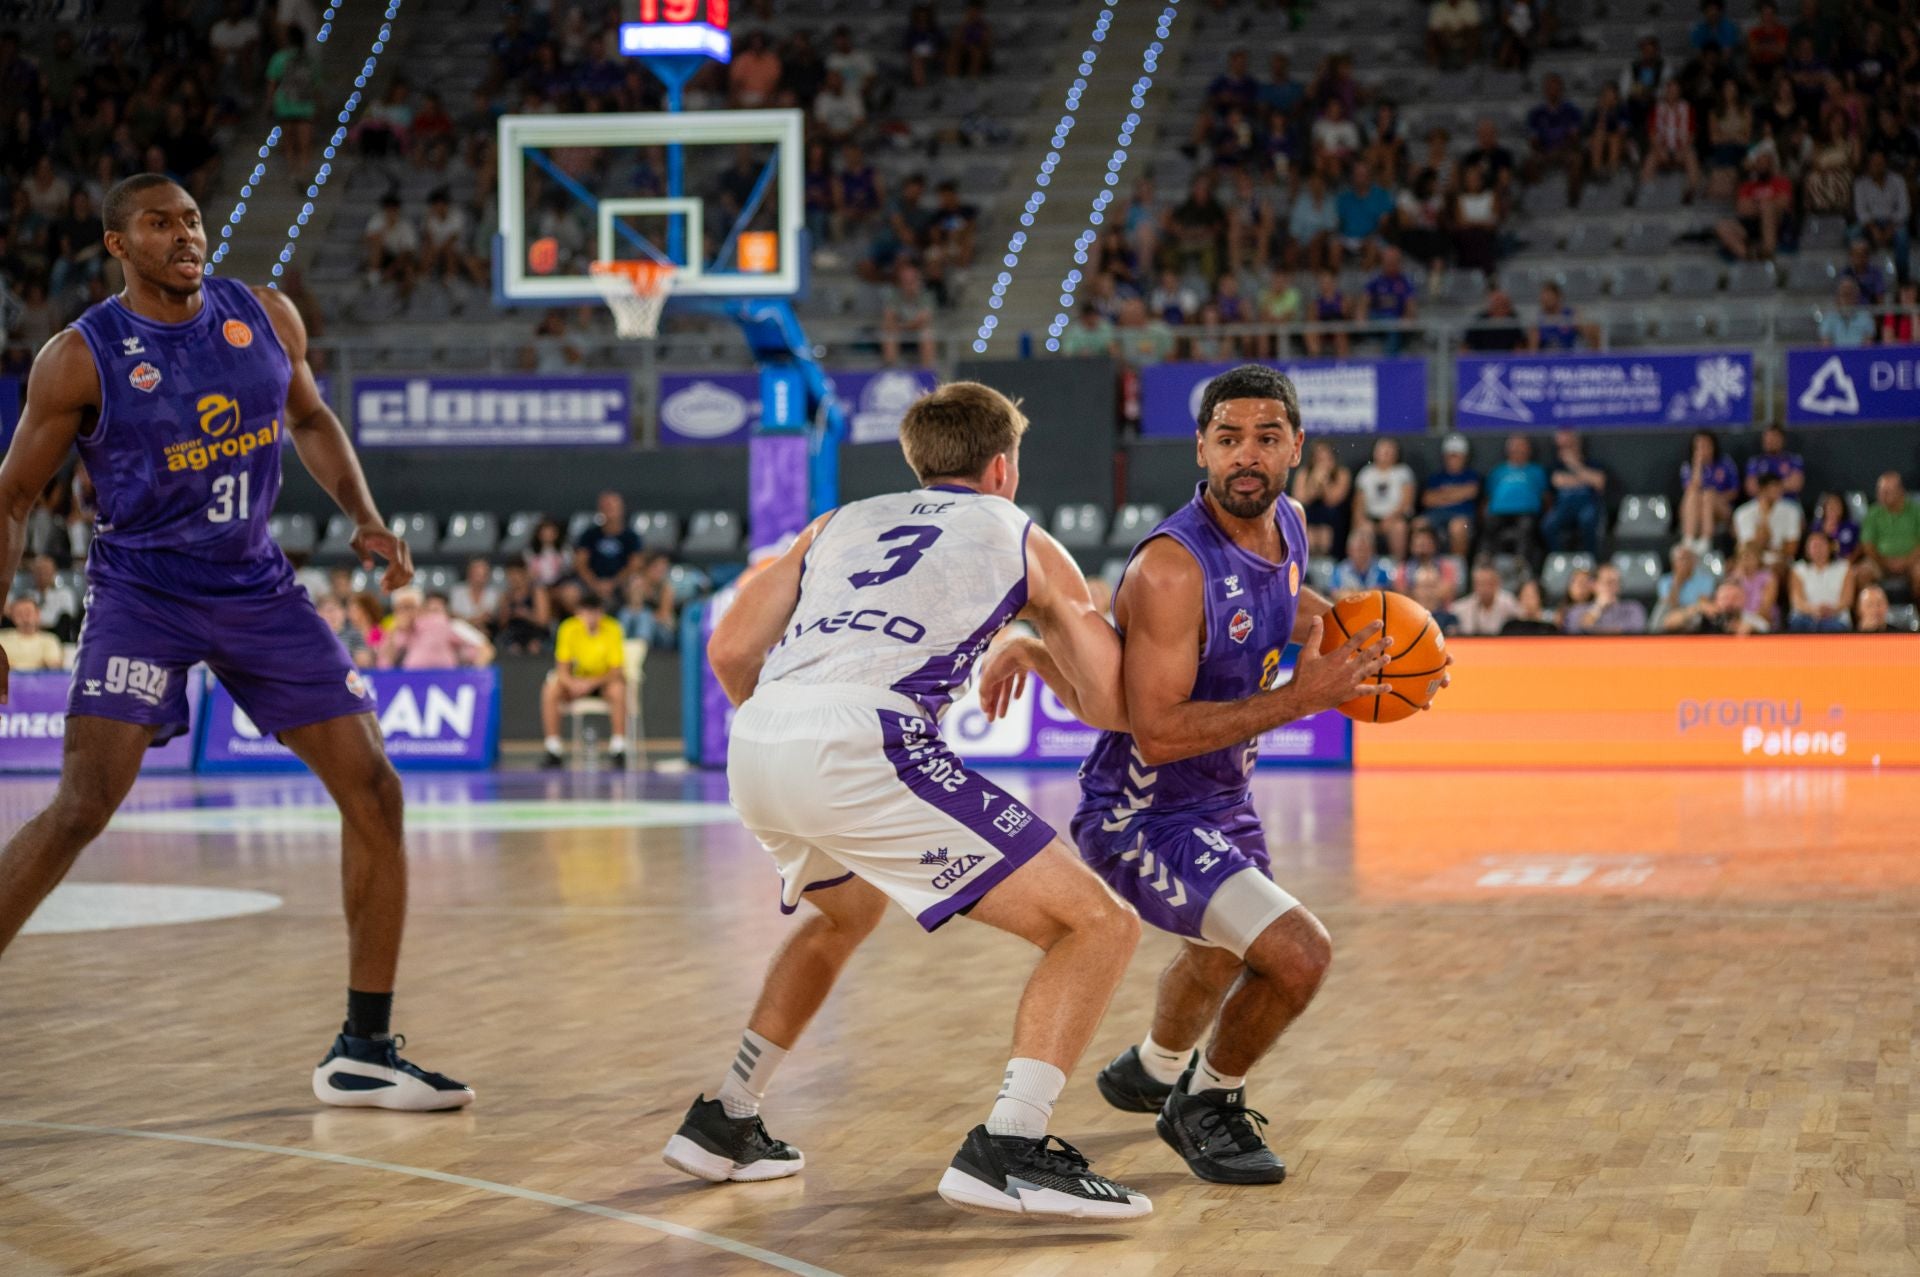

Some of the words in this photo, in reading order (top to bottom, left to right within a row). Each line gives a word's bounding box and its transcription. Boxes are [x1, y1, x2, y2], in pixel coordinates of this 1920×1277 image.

[167, 418, 279, 472] agropal
[207, 470, 249, 523] 31
[847, 524, 943, 590] 3
[992, 803, 1027, 833] CBC
[931, 853, 986, 890] CRZA
